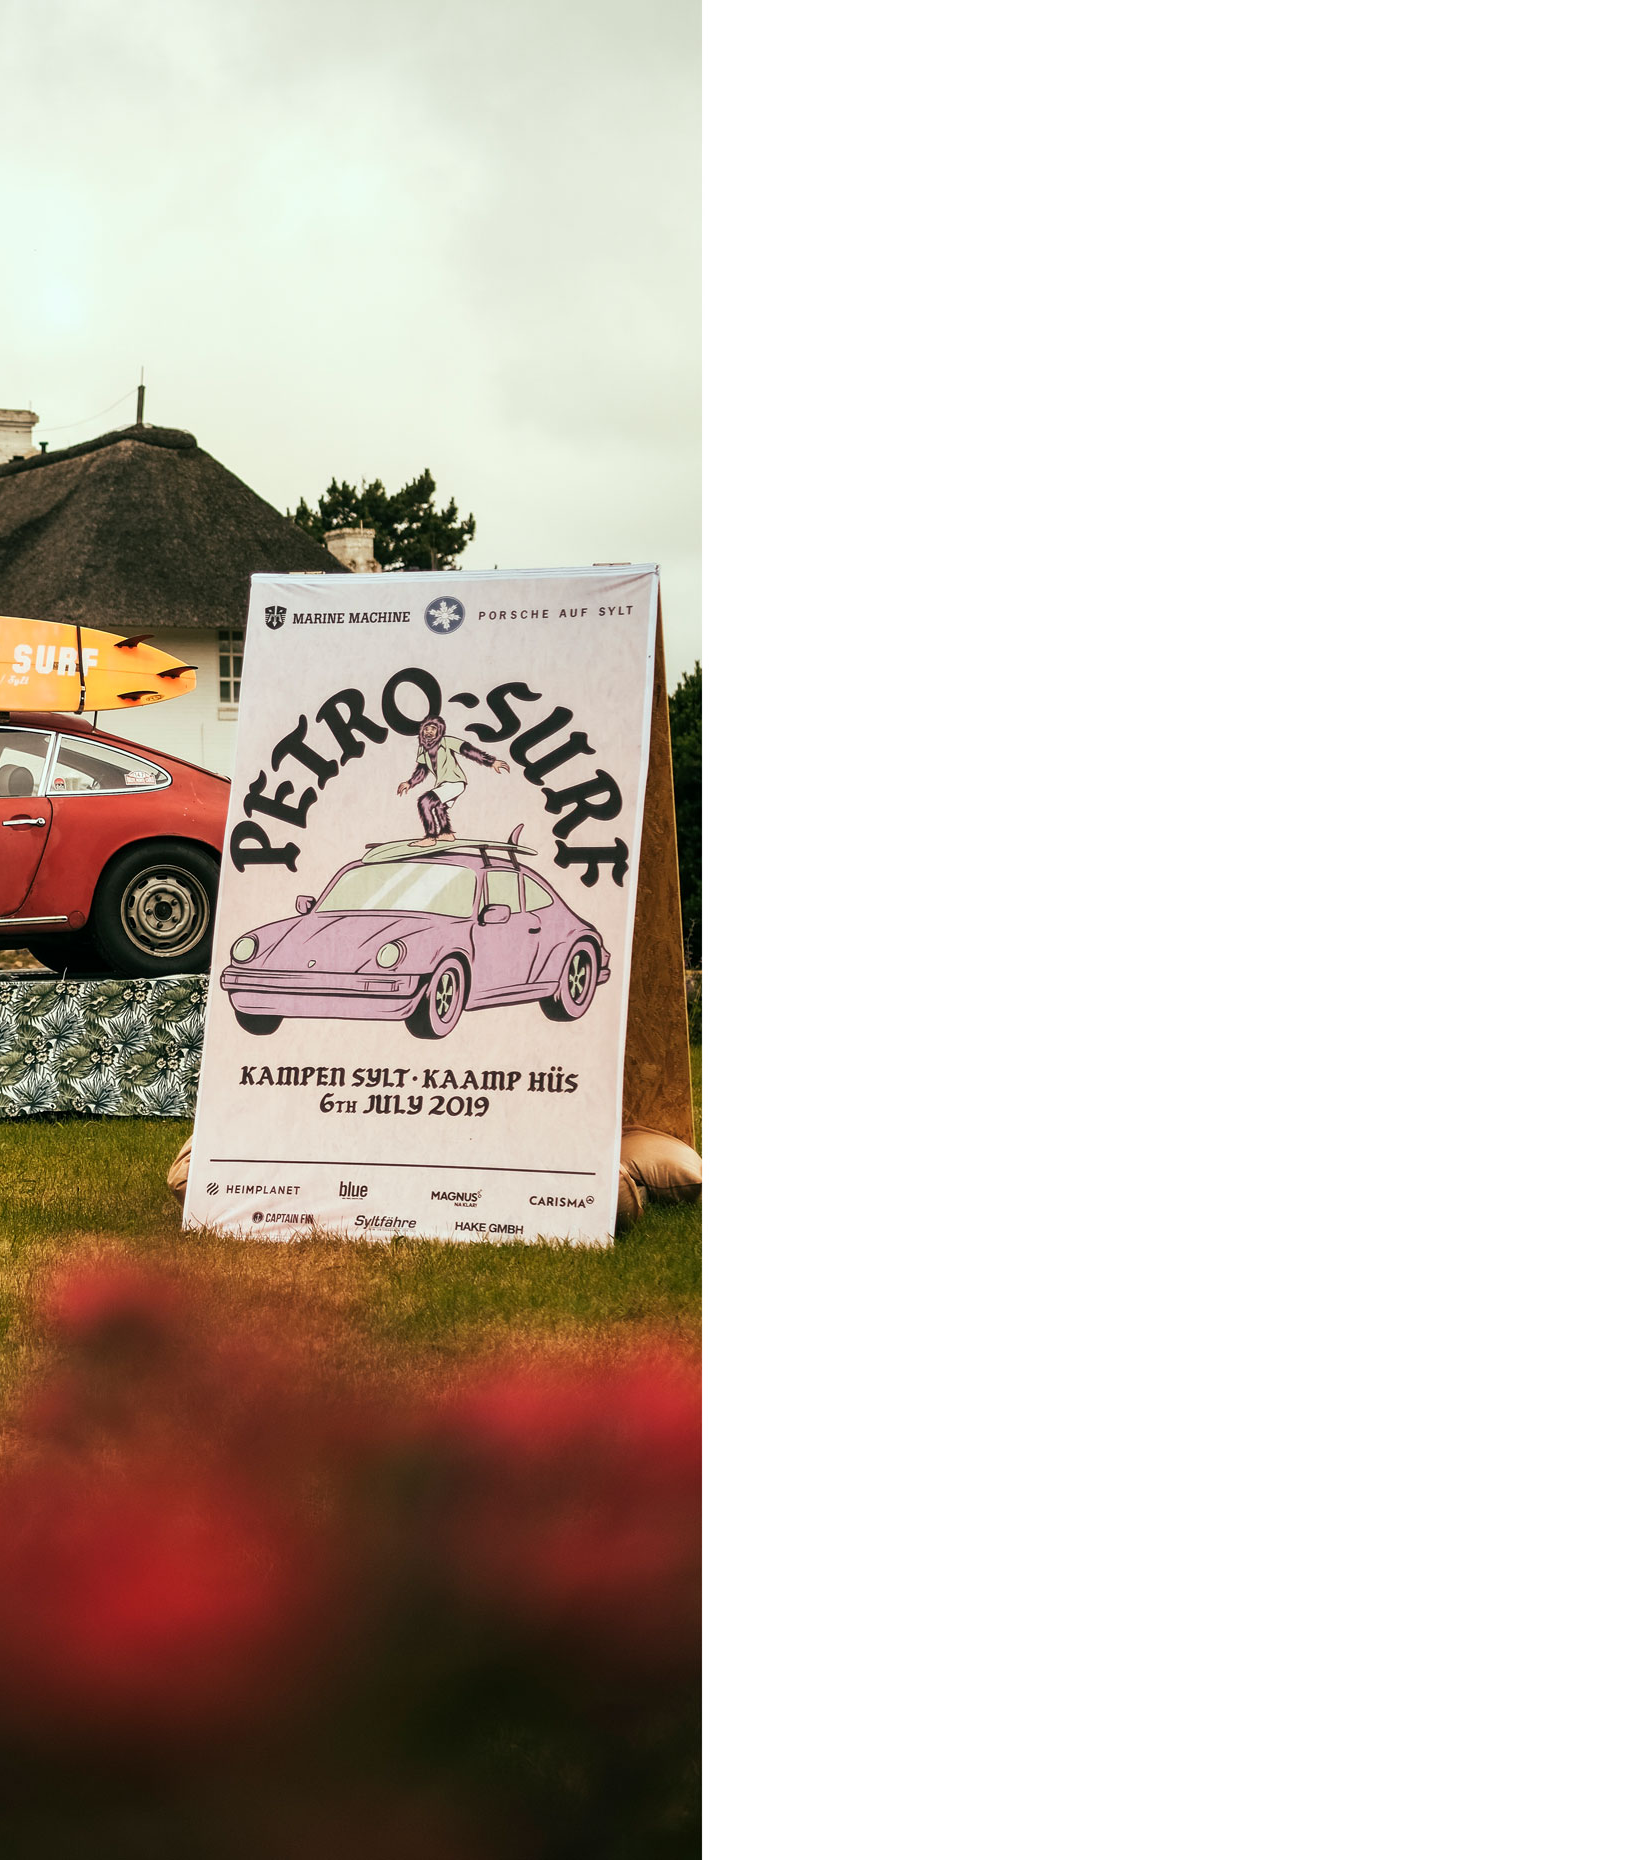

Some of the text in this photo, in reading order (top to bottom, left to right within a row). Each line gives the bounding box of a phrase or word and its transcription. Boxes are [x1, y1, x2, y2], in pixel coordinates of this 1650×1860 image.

[292, 611, 411, 624] MARINE MACHINE
[478, 605, 634, 621] PORSCHE AUF SYLT
[12, 644, 99, 677] SURF
[239, 1065, 346, 1087] KAMPEN
[527, 1066, 580, 1094] HÜS
[319, 1092, 490, 1117] 6TH JULY 2019
[226, 1184, 301, 1196] HEIMPLANET
[339, 1180, 368, 1198] blue
[430, 1190, 478, 1203] MAGNUS
[529, 1195, 586, 1209] CARISMA
[265, 1212, 299, 1224] CAPTAIN
[354, 1215, 417, 1230] Syltfähre
[455, 1221, 524, 1235] HAKE GMBH
